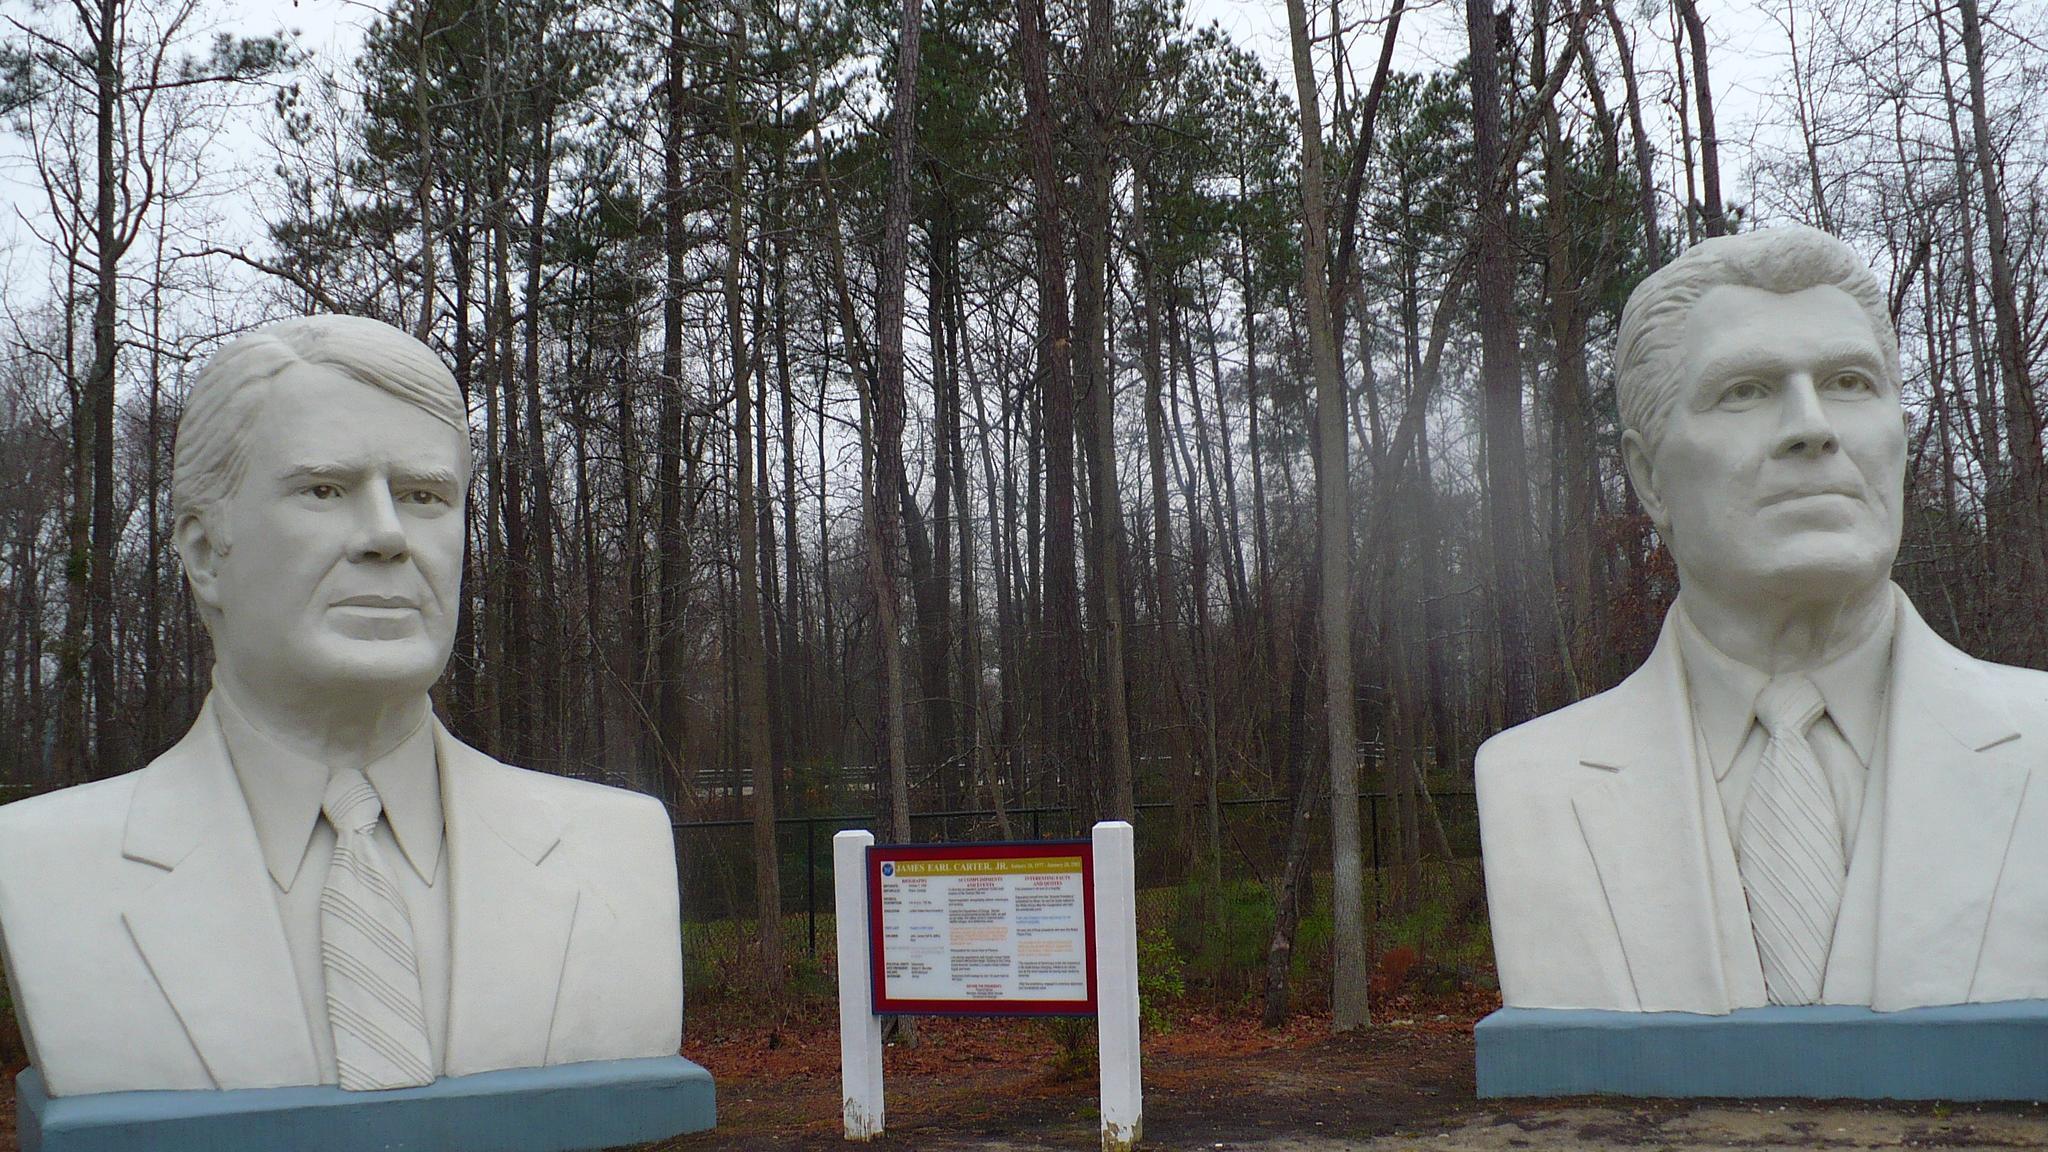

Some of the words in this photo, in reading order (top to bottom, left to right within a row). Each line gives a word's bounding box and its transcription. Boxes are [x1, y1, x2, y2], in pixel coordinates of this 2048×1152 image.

[896, 863, 925, 872] JAMES
[927, 862, 949, 872] EARL
[996, 861, 1008, 870] JR.
